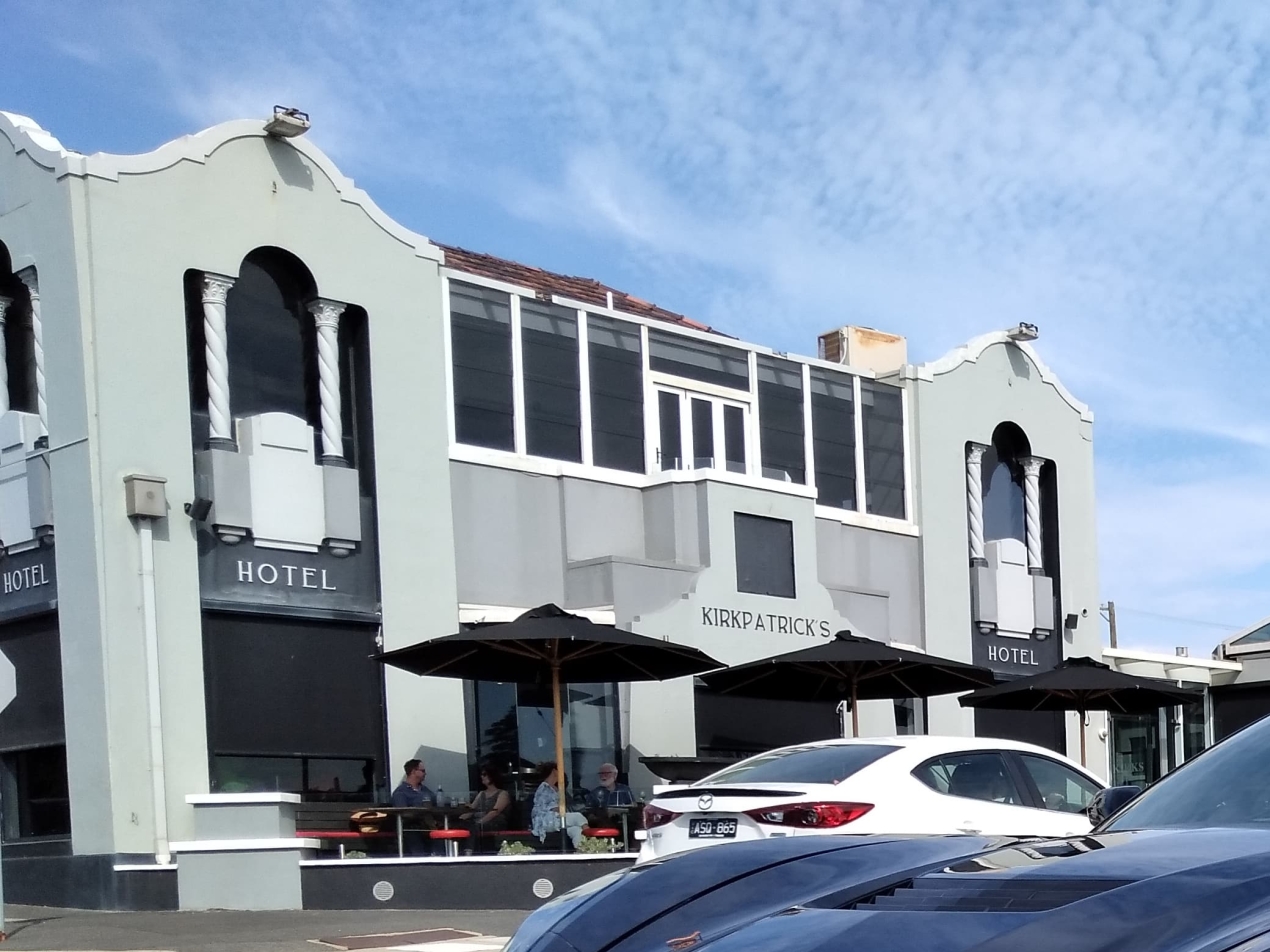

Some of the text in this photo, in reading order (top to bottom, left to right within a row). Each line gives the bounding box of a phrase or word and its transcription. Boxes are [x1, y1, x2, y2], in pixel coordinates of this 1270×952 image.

[3, 564, 49, 593] HOTEL
[237, 560, 337, 591] HOTEL
[701, 606, 831, 638] KIRKPATRICK'S
[988, 645, 1039, 666] HOTEL
